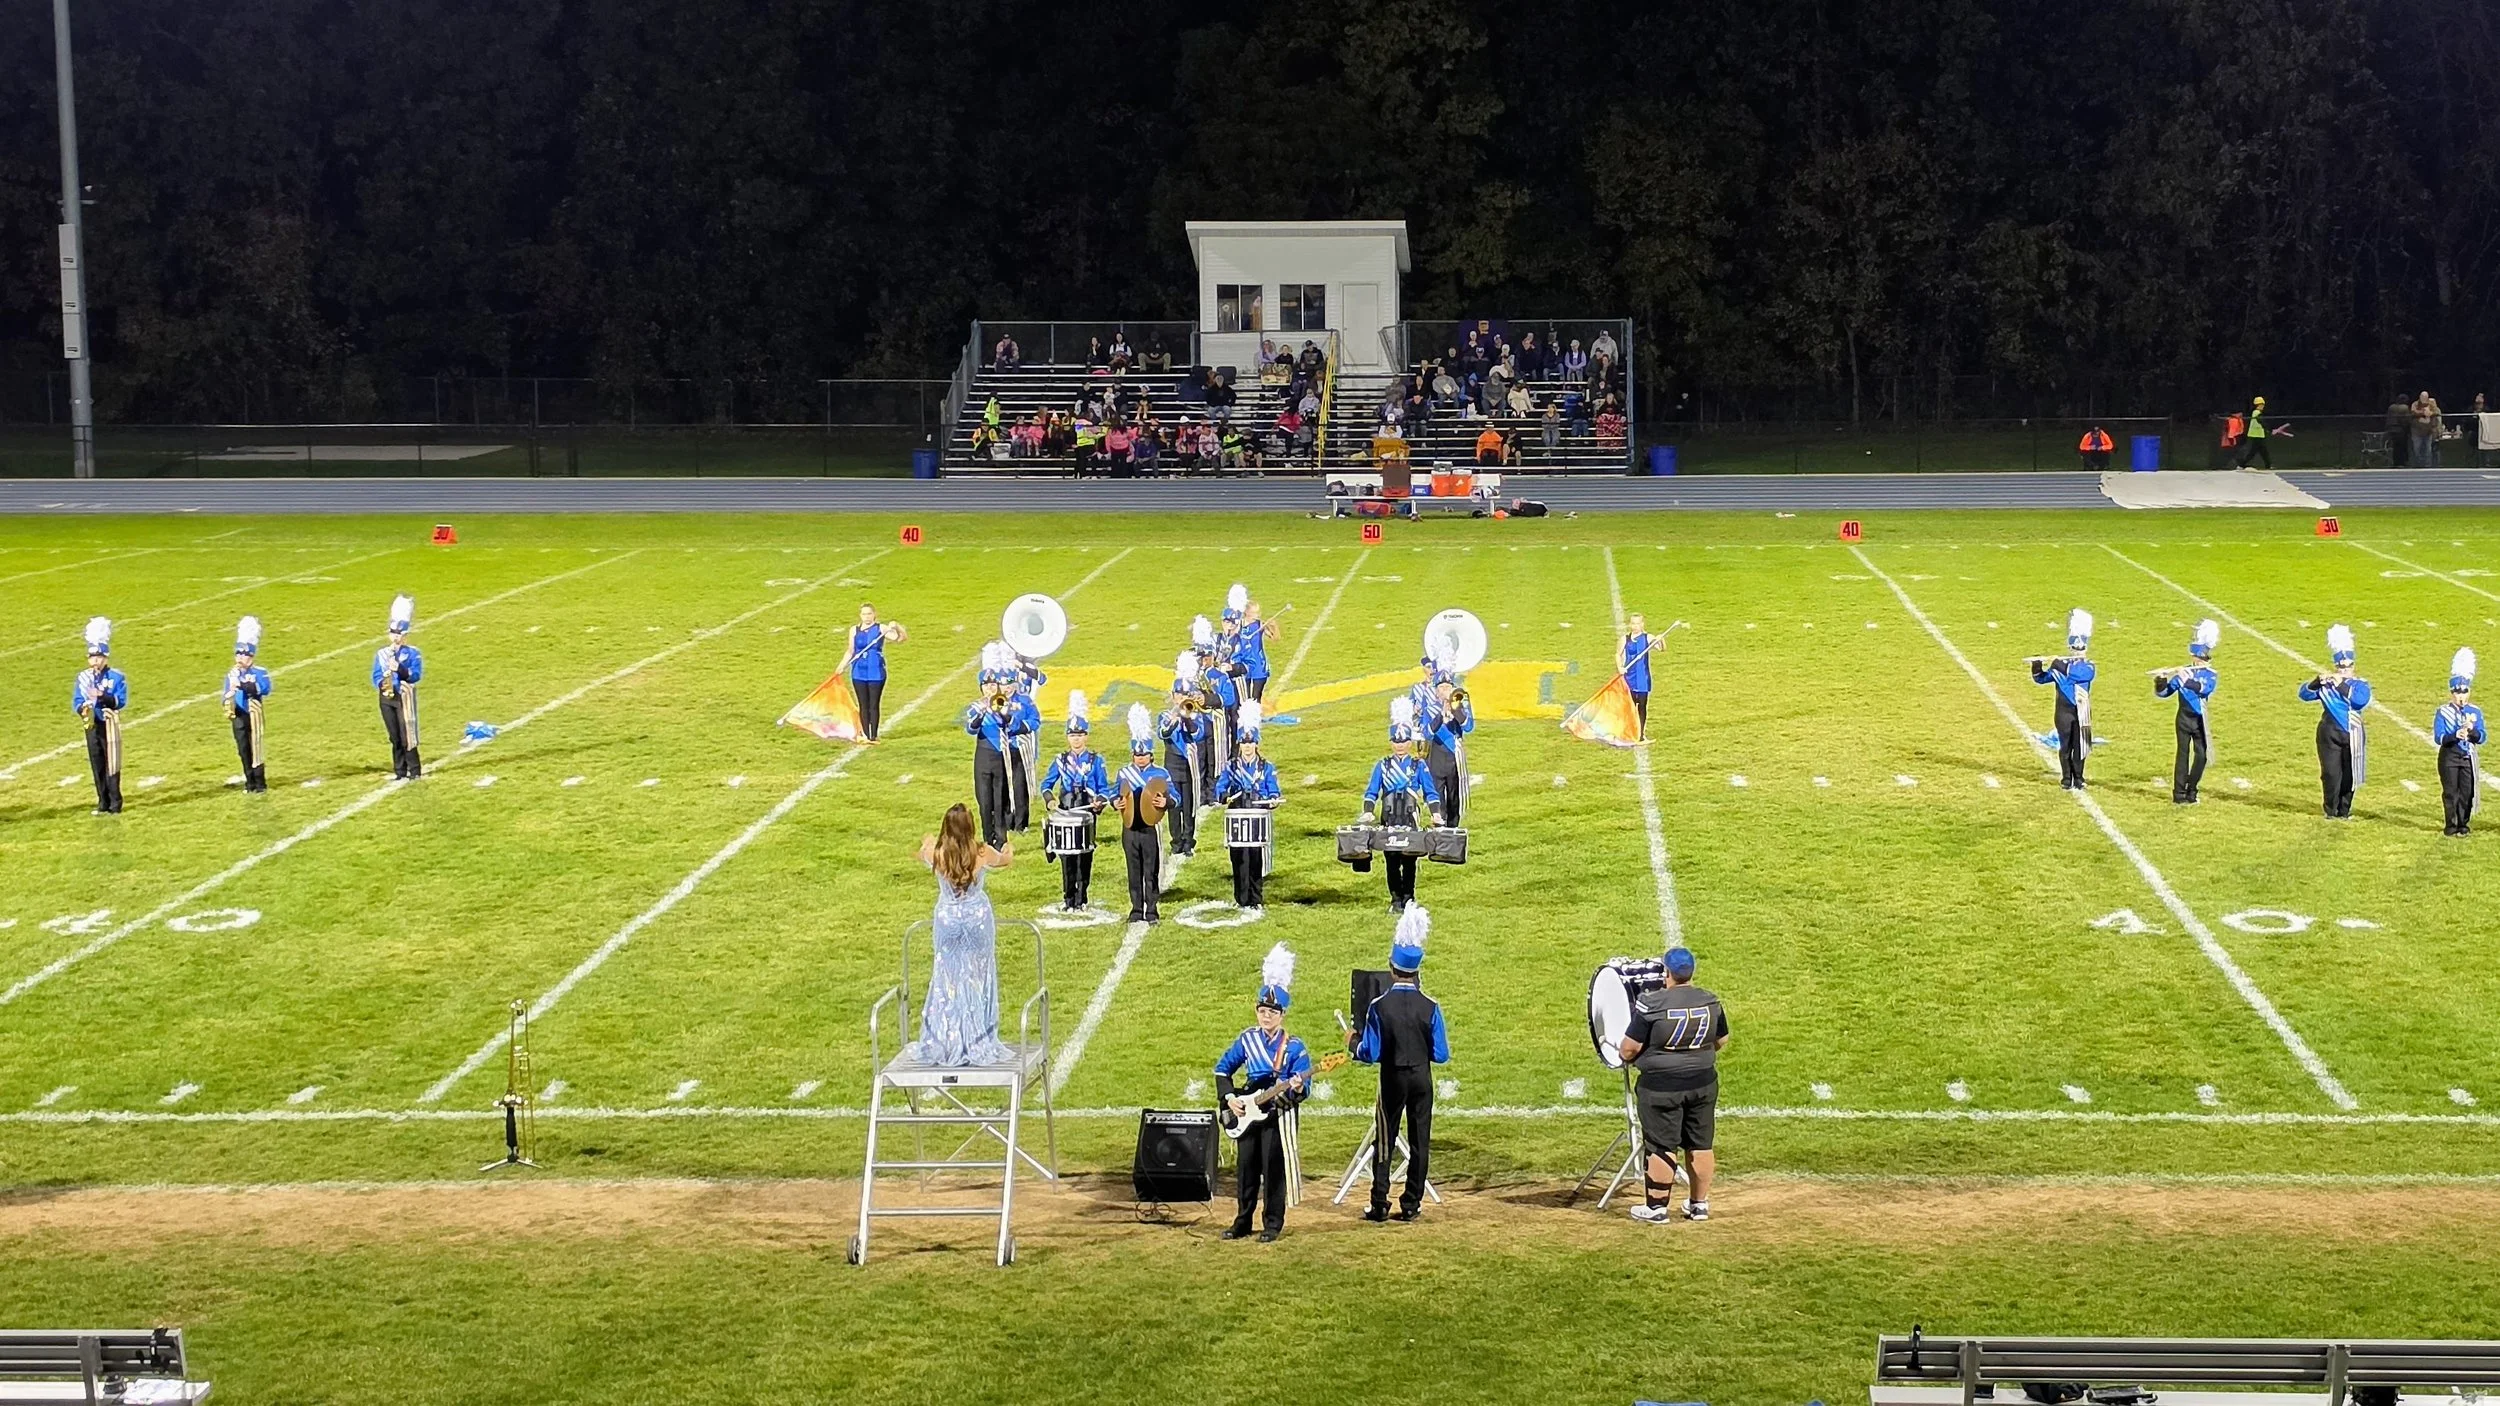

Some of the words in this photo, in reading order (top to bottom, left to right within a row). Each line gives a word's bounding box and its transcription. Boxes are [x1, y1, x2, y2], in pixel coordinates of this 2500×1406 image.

[1364, 524, 1381, 539] 50
[1842, 521, 1860, 537] 40
[2322, 518, 2339, 533] 30
[902, 527, 919, 542] 40
[1664, 1005, 1711, 1050] 77
